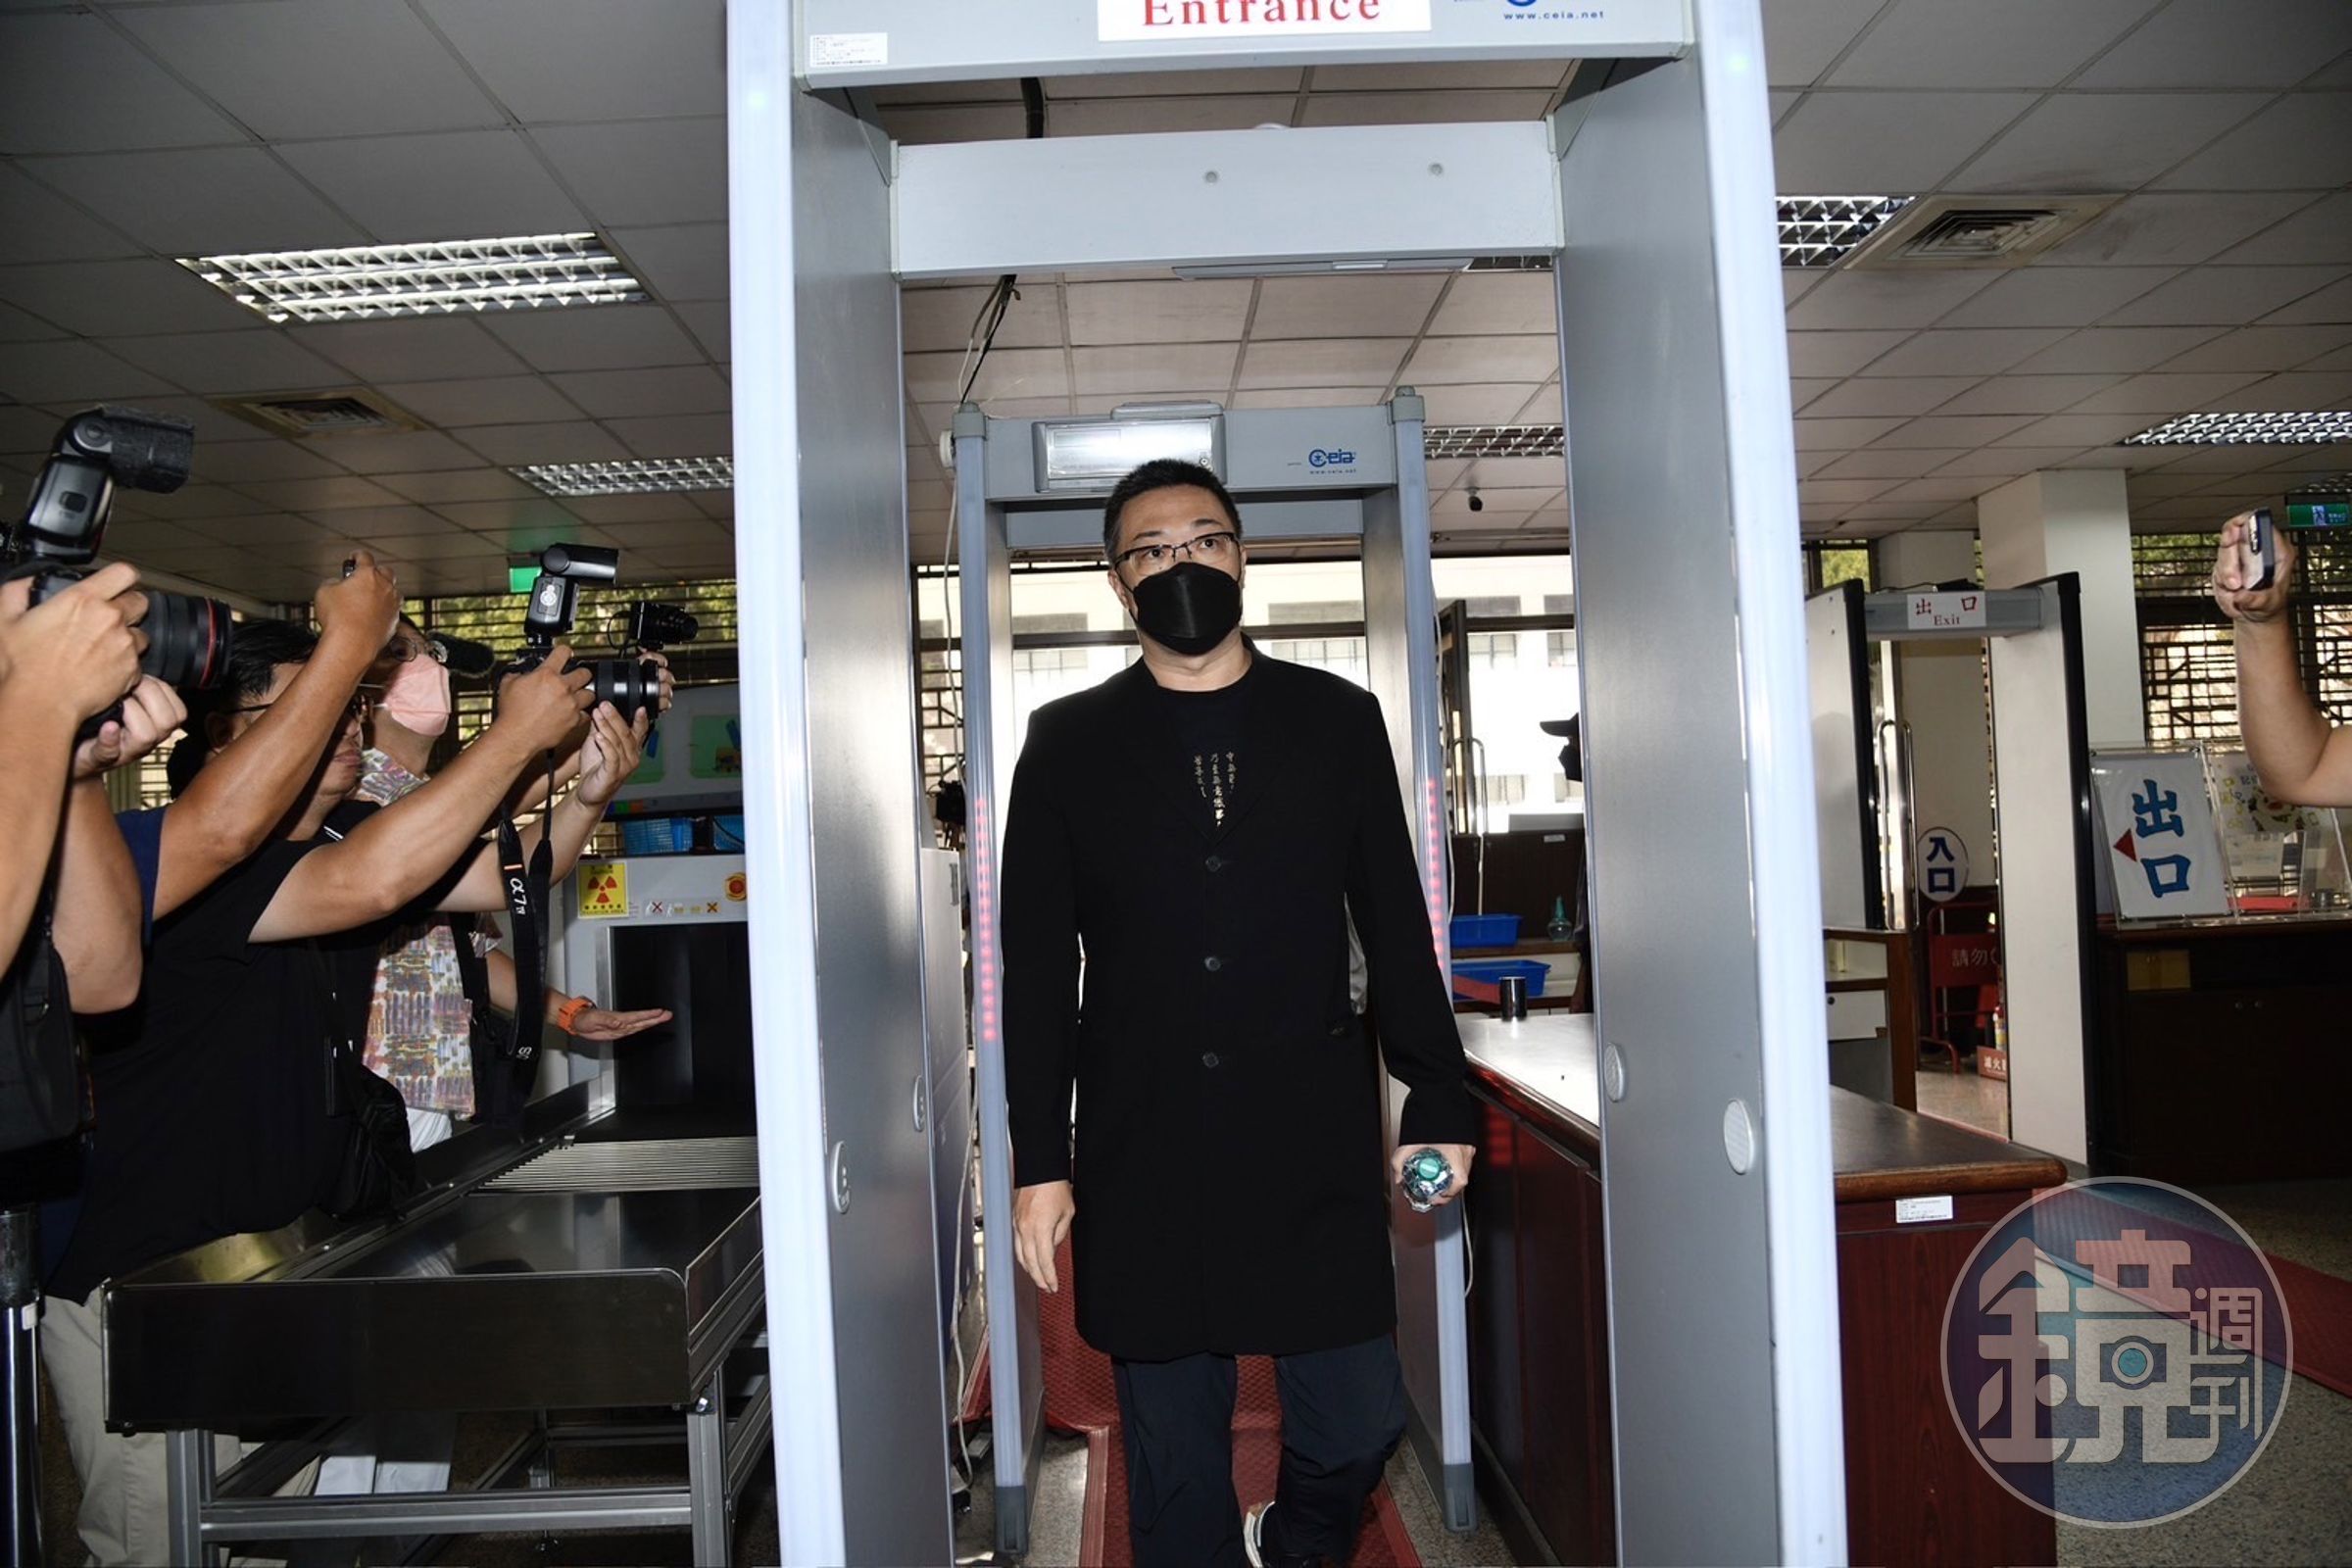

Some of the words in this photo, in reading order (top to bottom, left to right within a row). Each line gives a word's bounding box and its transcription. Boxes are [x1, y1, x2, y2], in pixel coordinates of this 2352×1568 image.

[1143, 0, 1380, 26] Entrance
[1503, 10, 1604, 20] www.ceia.net
[1916, 596, 1978, 615] 出口
[1934, 613, 1960, 626] Exit
[2132, 778, 2191, 899] 出口
[1927, 837, 1955, 894] 入口
